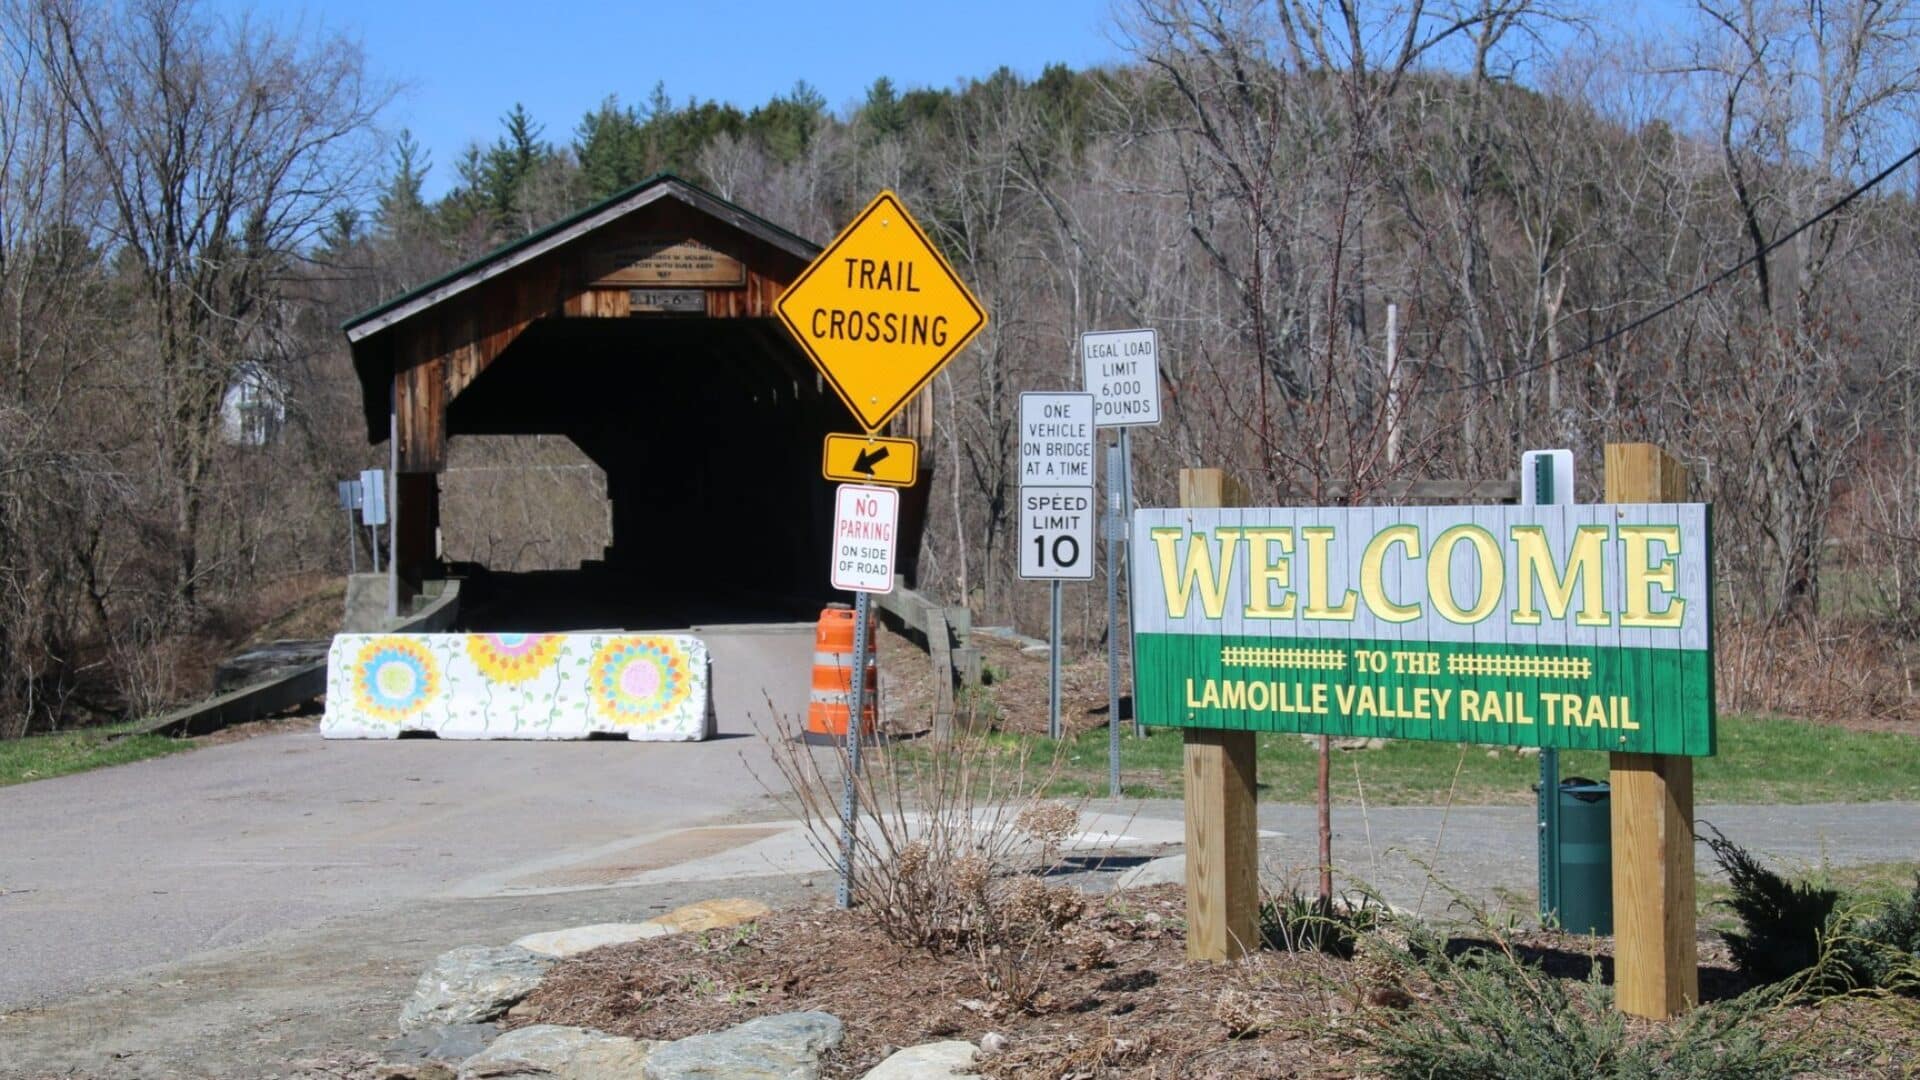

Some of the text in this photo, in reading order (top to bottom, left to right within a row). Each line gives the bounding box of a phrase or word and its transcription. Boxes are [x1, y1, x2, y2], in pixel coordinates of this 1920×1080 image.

[845, 258, 920, 292] TRAIL
[811, 308, 948, 348] CROSSING
[1087, 341, 1151, 359] LEGAL LOAD
[1103, 362, 1136, 377] LIMIT
[1102, 381, 1141, 398] 6,000
[1044, 404, 1070, 418] ONE
[1096, 400, 1150, 416] POUNDS
[1029, 424, 1085, 437] VEHICLE
[1024, 442, 1090, 456] ON BRIDGE
[1026, 462, 1088, 475] AT A TIME
[855, 499, 878, 518] NO
[1028, 497, 1087, 510] SPEED
[840, 520, 891, 541] PARKING
[1033, 516, 1080, 529] LIMIT
[842, 545, 887, 560] ON SIDE
[1034, 535, 1079, 567] 10
[839, 561, 887, 575] OF ROAD
[1152, 522, 1686, 628] WELCOME
[1355, 649, 1440, 676] TO THE
[1186, 678, 1640, 729] LAMOILLE VALLEY RAIL TRAIL
